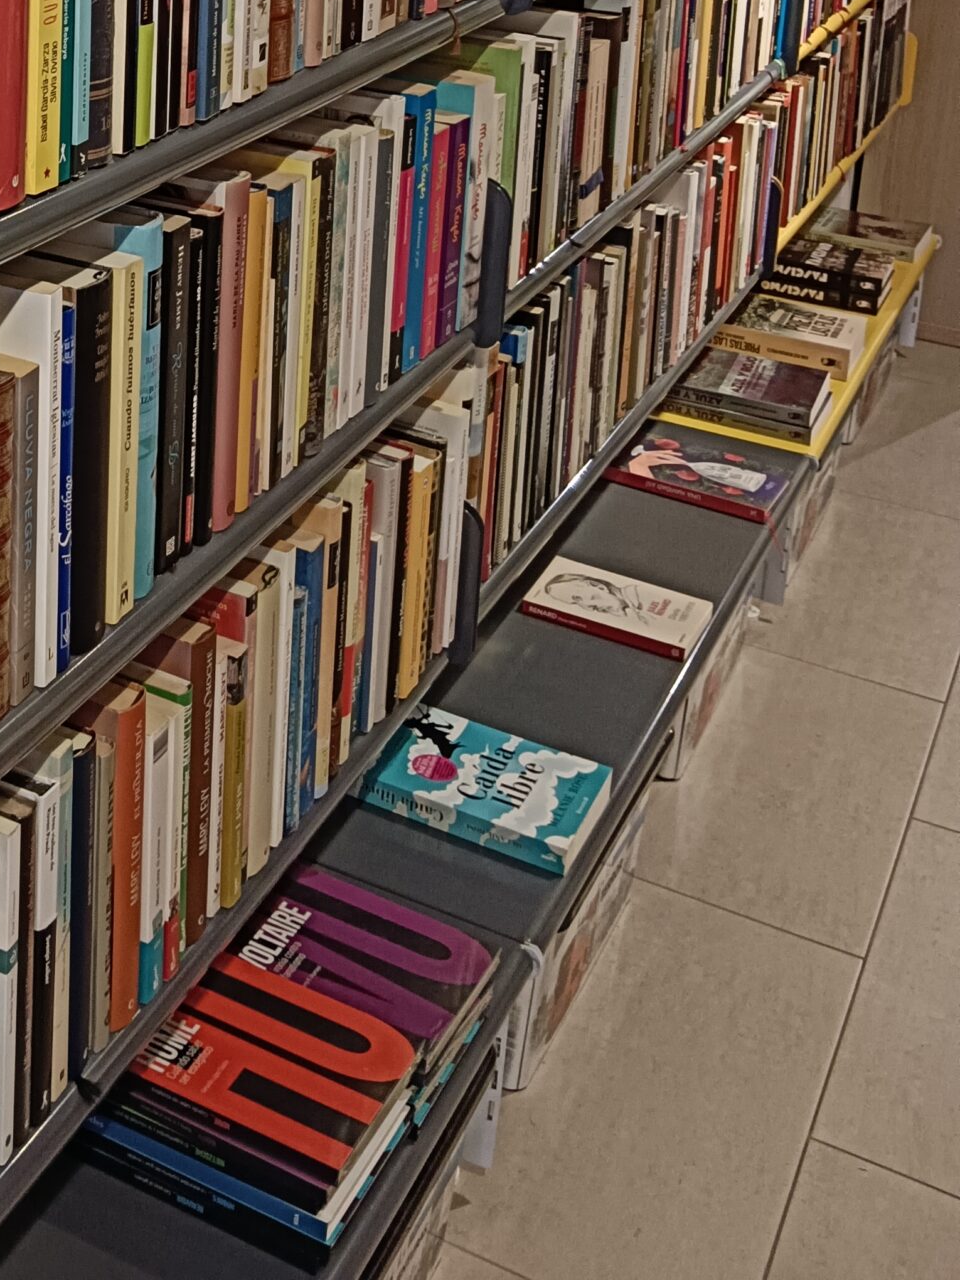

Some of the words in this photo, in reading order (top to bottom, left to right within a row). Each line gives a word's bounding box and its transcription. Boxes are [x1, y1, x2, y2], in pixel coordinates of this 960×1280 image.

[127, 270, 136, 341] huérfanos
[25, 395, 33, 481] LLUVIA
[125, 400, 133, 452] Cuando
[24, 491, 33, 570] NEGRA
[457, 747, 517, 802] Caída
[491, 761, 546, 810] libre
